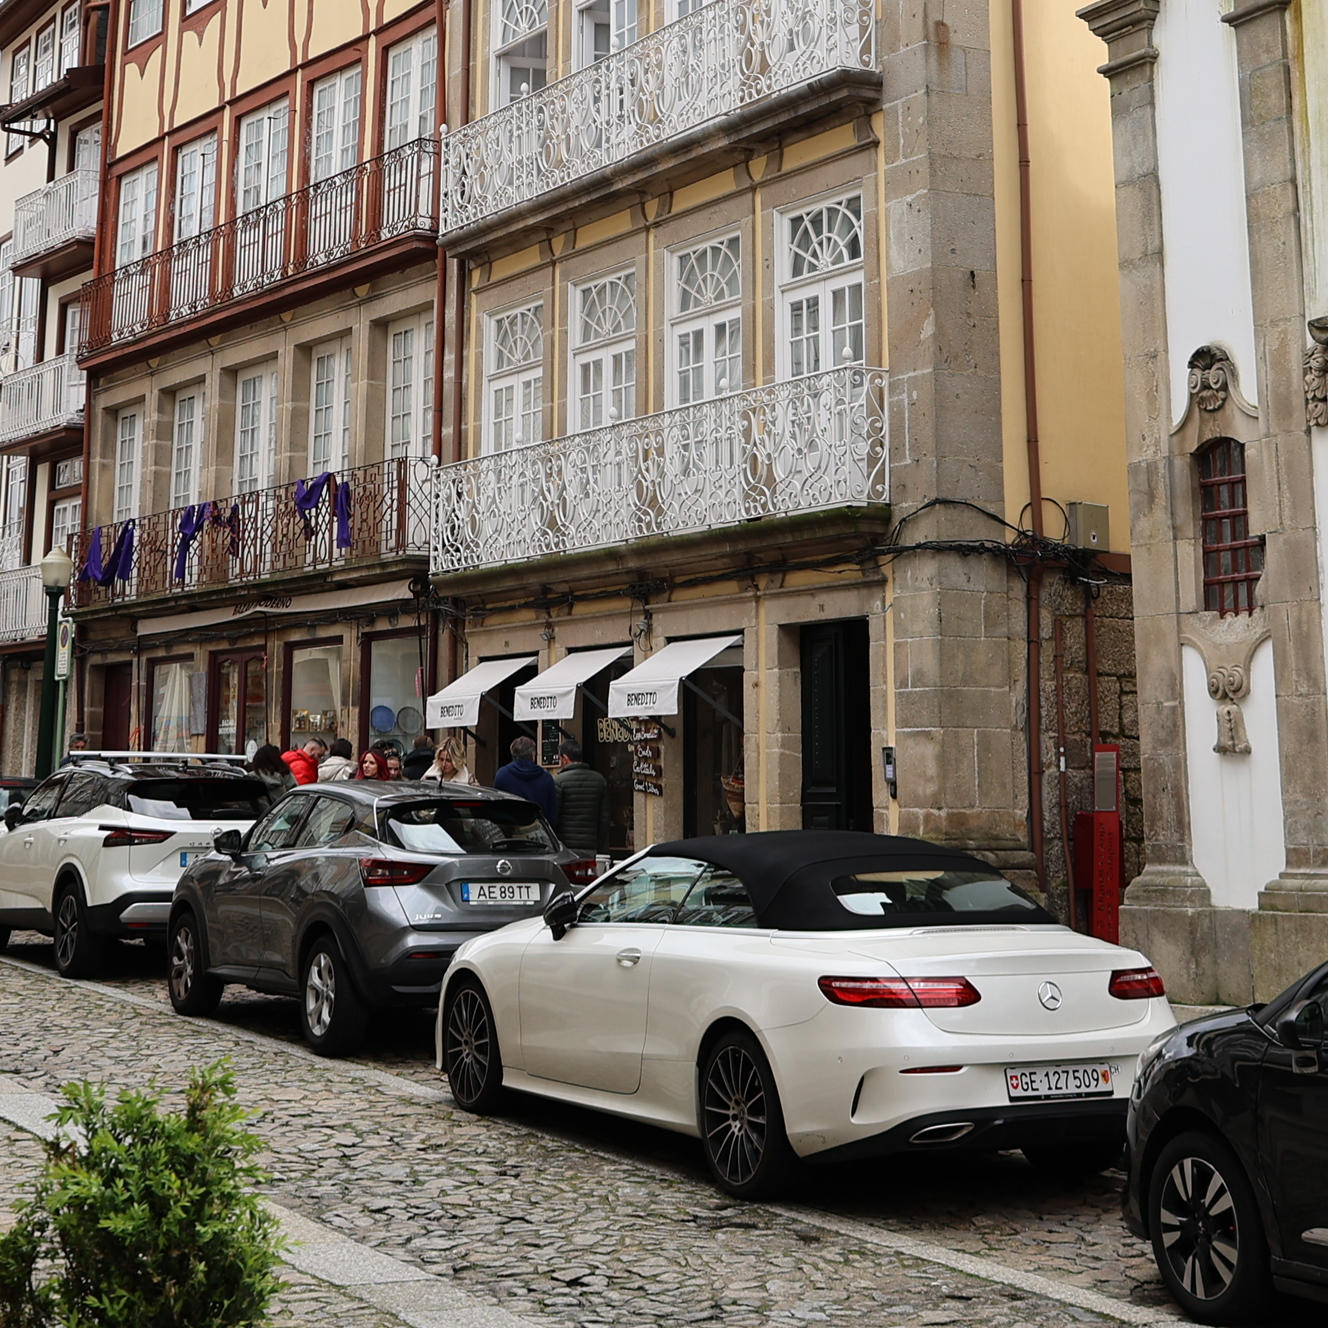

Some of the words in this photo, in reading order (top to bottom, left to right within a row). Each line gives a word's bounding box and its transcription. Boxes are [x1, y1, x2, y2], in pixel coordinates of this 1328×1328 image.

[530, 692, 558, 710] BENEDITO
[626, 691, 657, 707] BENEDITO
[440, 703, 464, 718] BENEDITO
